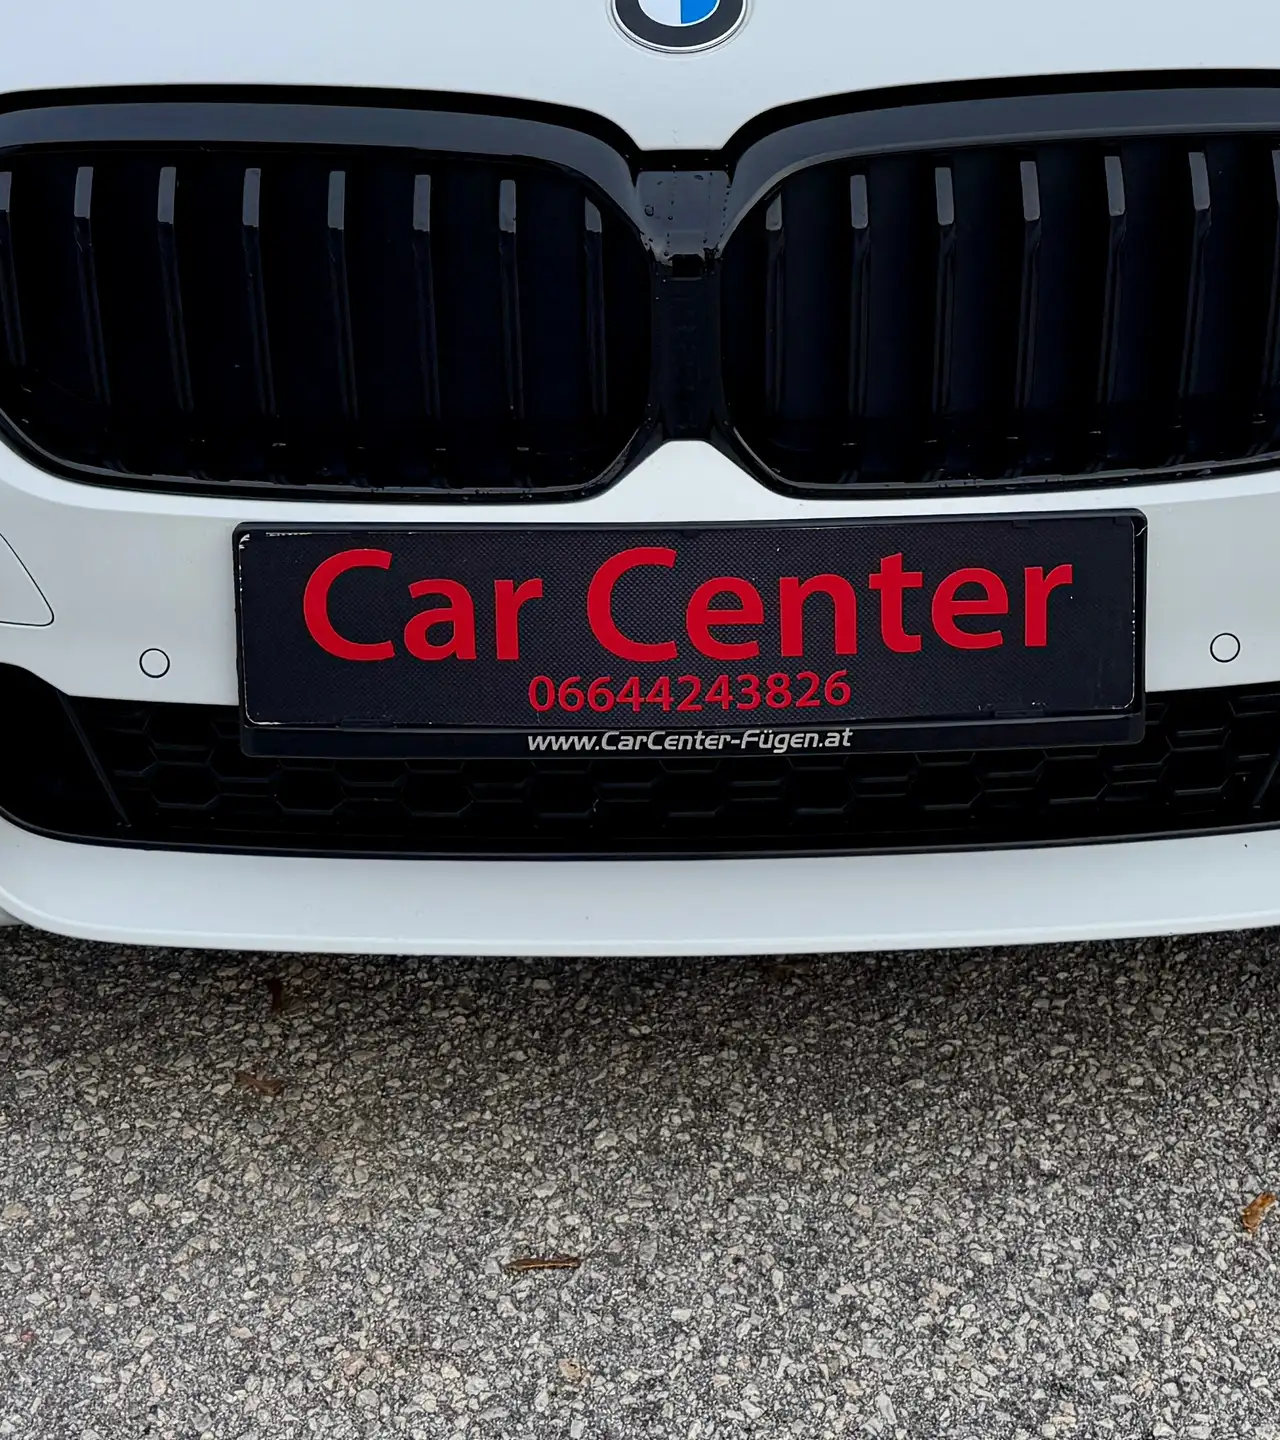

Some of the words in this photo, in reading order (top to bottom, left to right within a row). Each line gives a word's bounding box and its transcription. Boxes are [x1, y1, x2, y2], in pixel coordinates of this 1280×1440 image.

[303, 549, 543, 662] Car
[587, 547, 1073, 662] Center
[528, 670, 853, 712] 06644243826
[527, 727, 854, 754] www.CarCenter-Fügen.at
